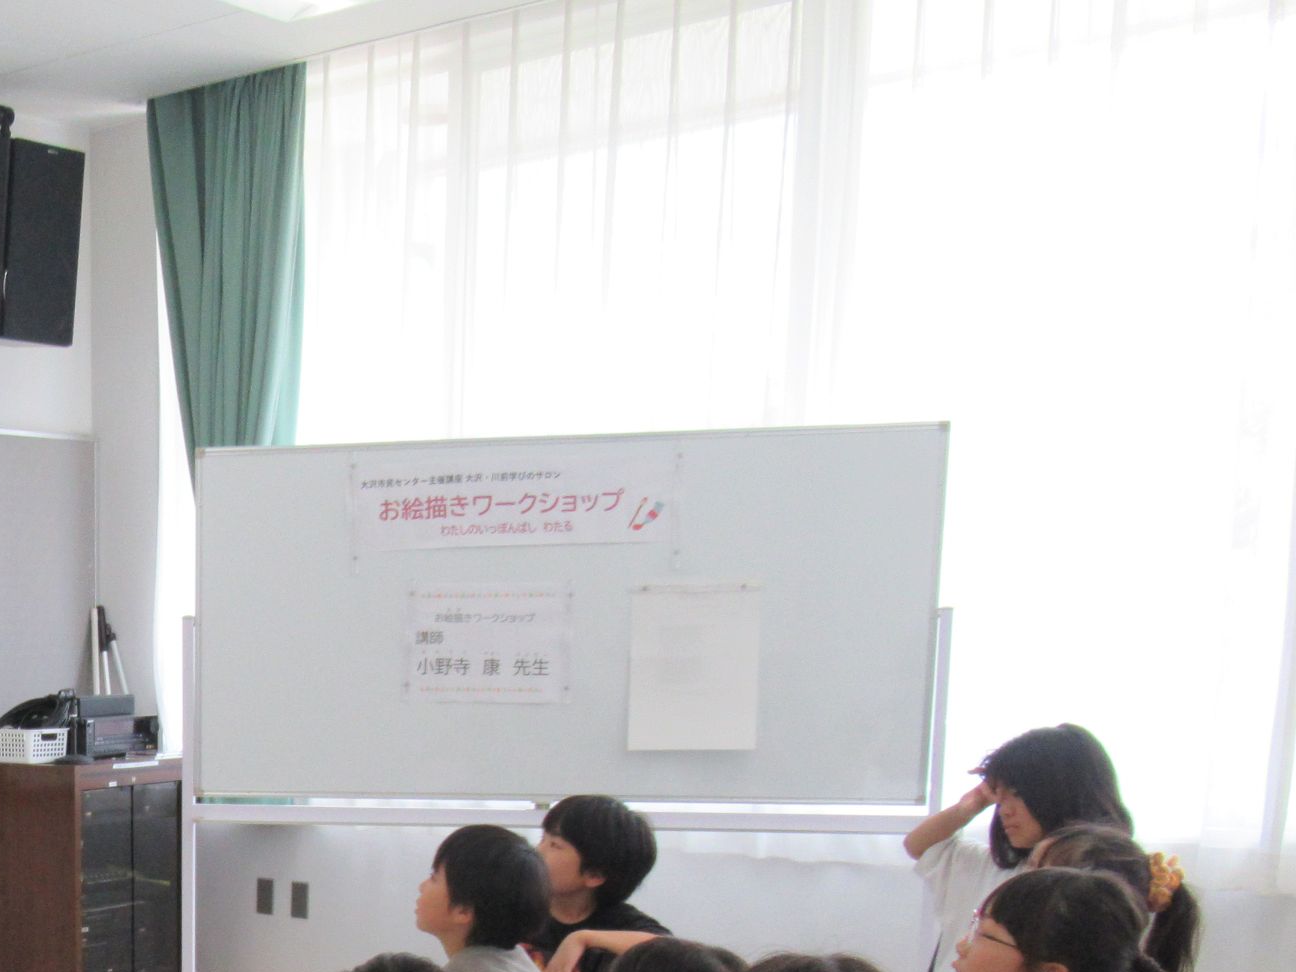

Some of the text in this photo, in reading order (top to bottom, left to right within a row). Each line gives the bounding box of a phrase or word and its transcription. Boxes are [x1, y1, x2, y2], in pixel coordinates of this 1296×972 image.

[378, 487, 625, 522] お絵描きワークショップ
[543, 519, 574, 534] わたる
[434, 613, 536, 624] お絵描きワークショップ
[415, 630, 444, 645] 講師
[416, 657, 550, 677] 小野寺 康 先生
